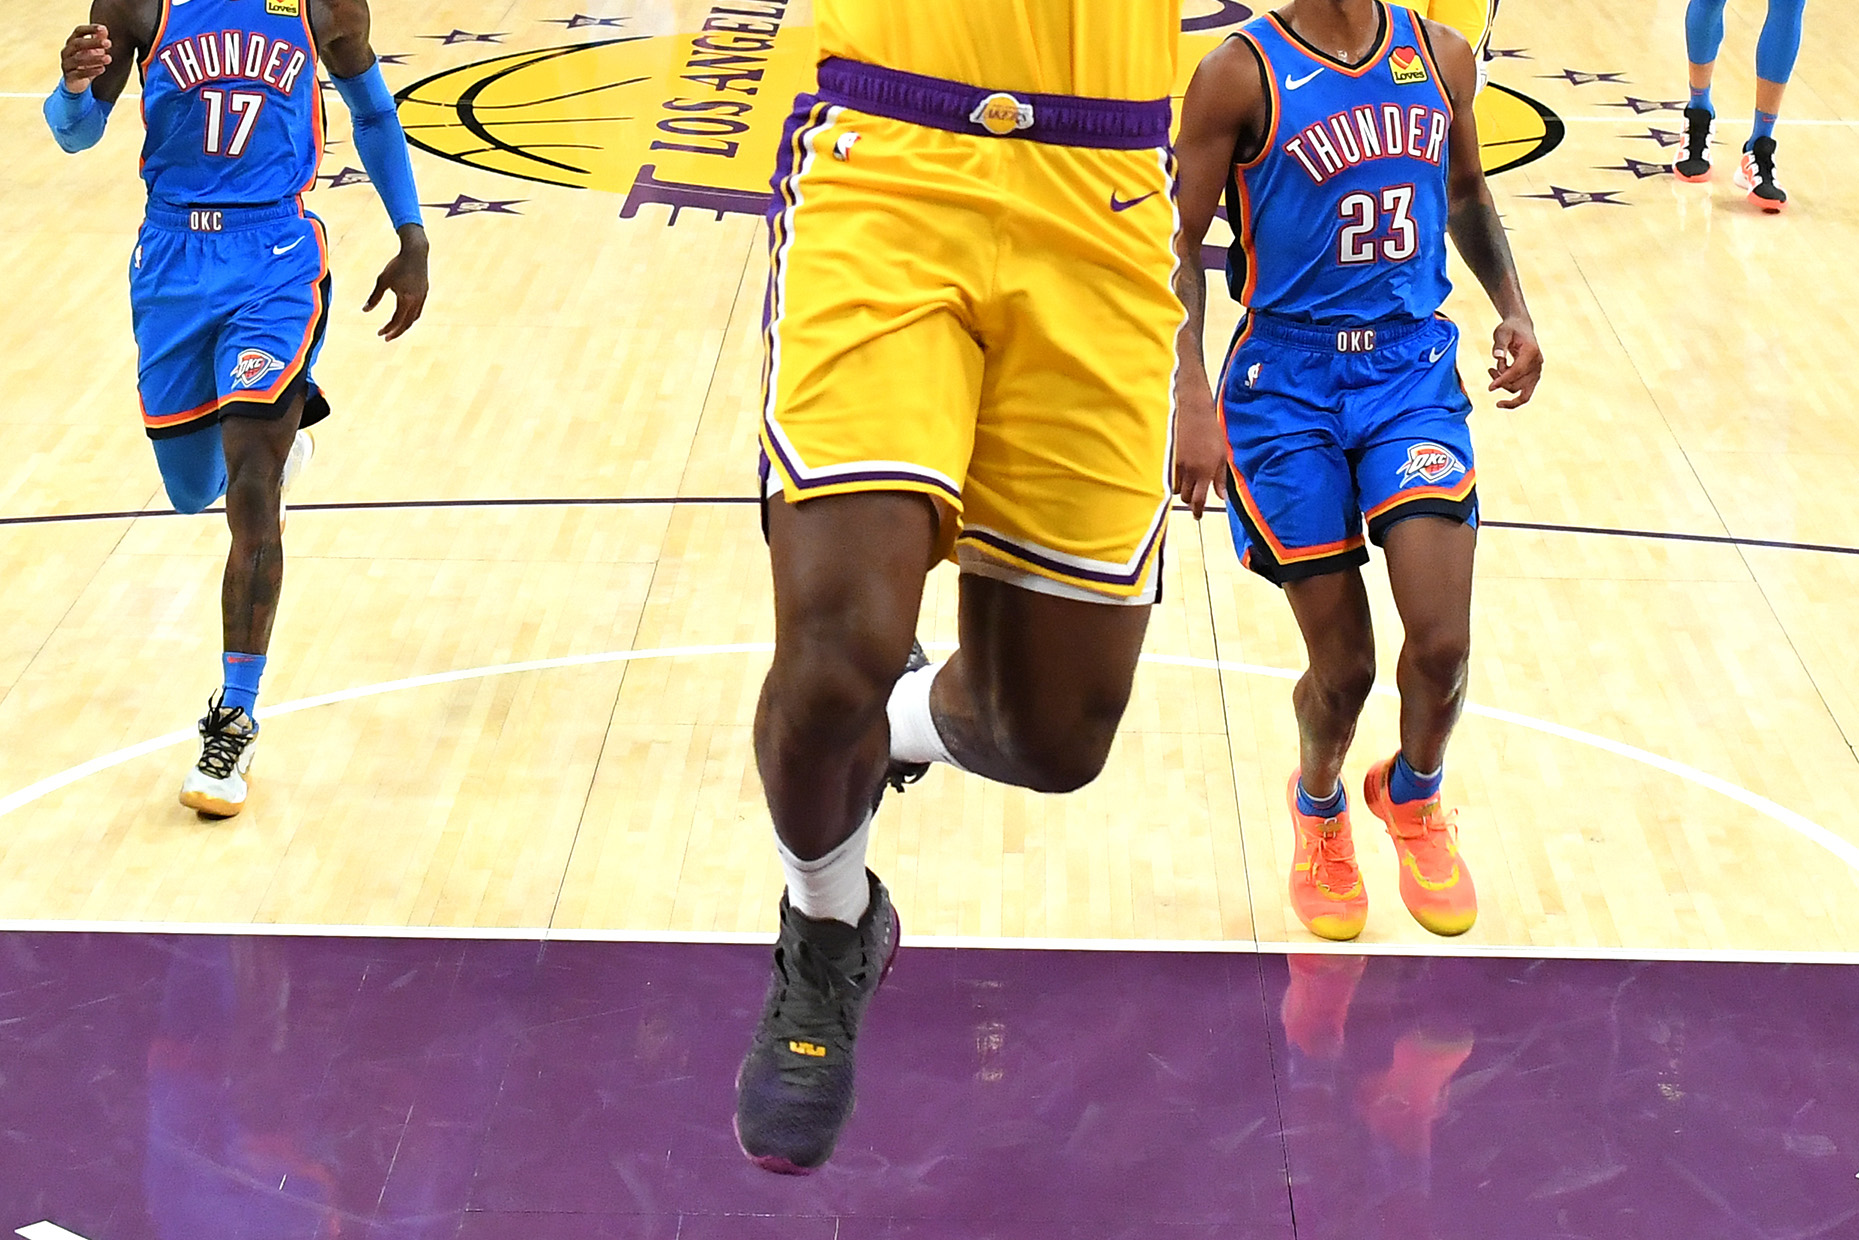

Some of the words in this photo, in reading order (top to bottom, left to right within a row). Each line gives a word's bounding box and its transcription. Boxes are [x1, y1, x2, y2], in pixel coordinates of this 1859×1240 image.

[158, 29, 307, 96] THUNDER
[201, 89, 265, 158] 17
[649, 97, 753, 158] LOS
[1282, 103, 1450, 187] THUNDER
[189, 210, 223, 232] OKC
[1337, 182, 1419, 267] 23
[1336, 329, 1376, 354] OKC
[1407, 453, 1448, 475] OKC
